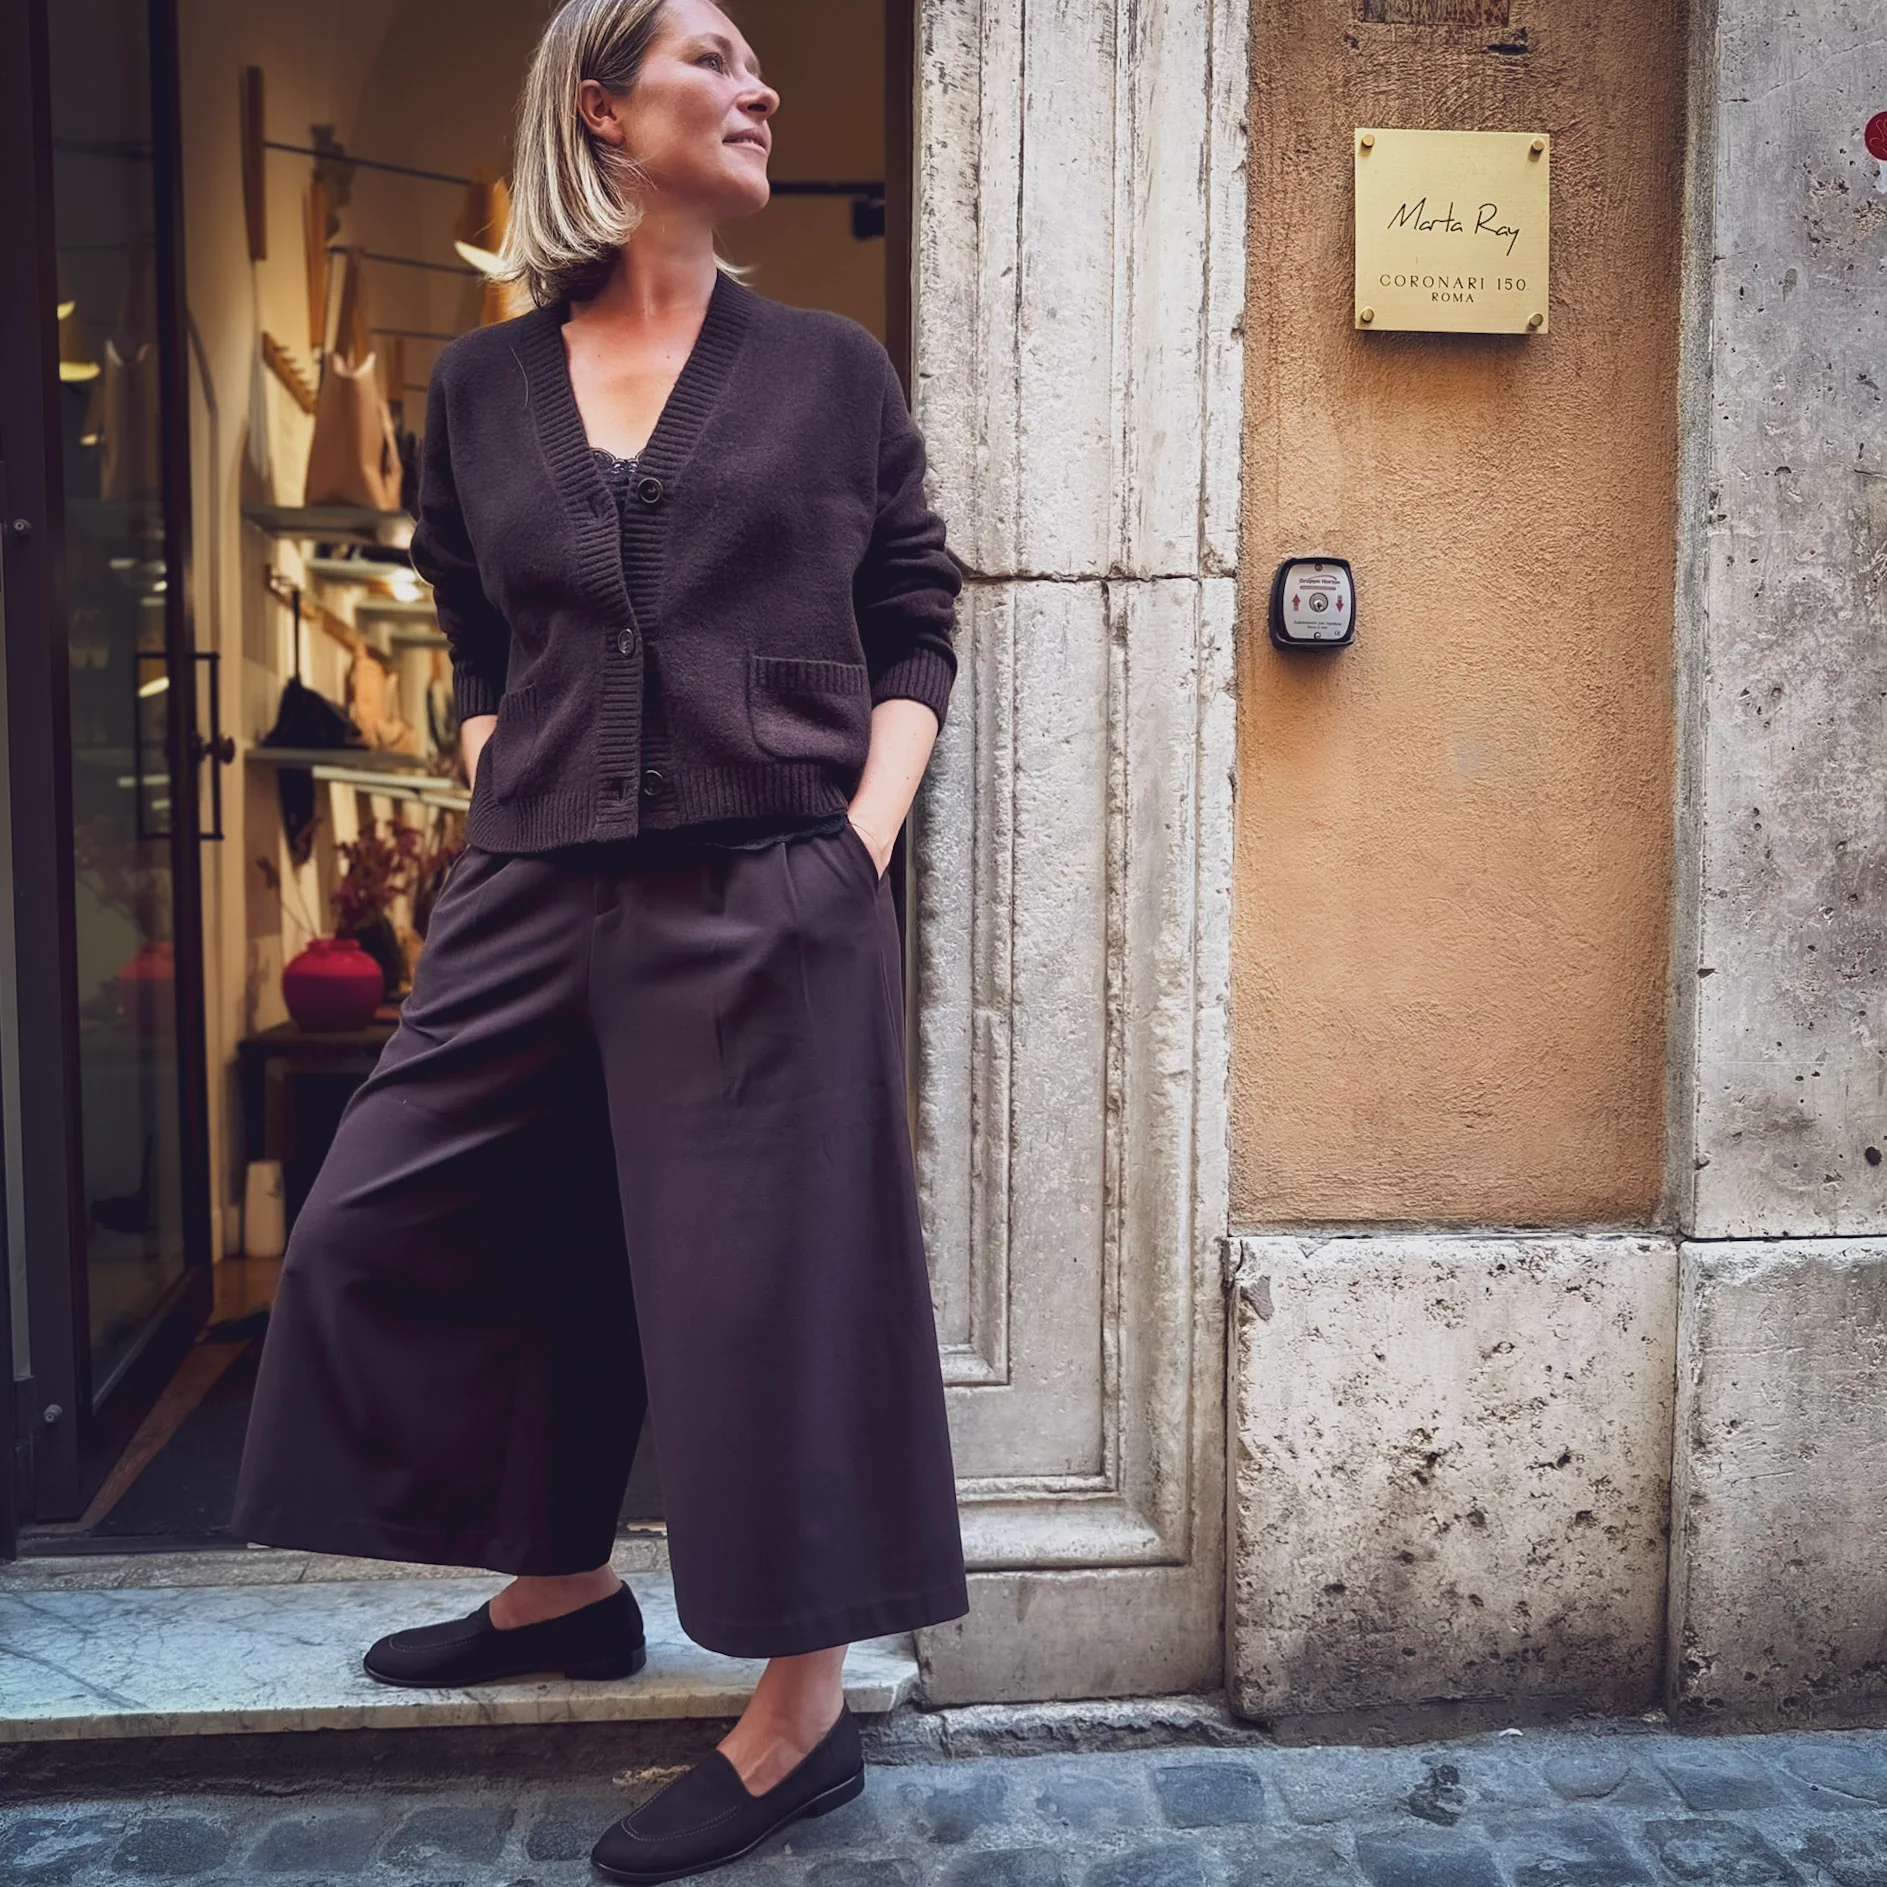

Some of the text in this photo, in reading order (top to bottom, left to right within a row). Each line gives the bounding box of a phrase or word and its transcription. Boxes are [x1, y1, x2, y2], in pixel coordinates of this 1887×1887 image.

[1387, 197, 1520, 256] Marta Ray
[1379, 274, 1527, 291] CORONARI 150
[1431, 292, 1475, 303] ROMA
